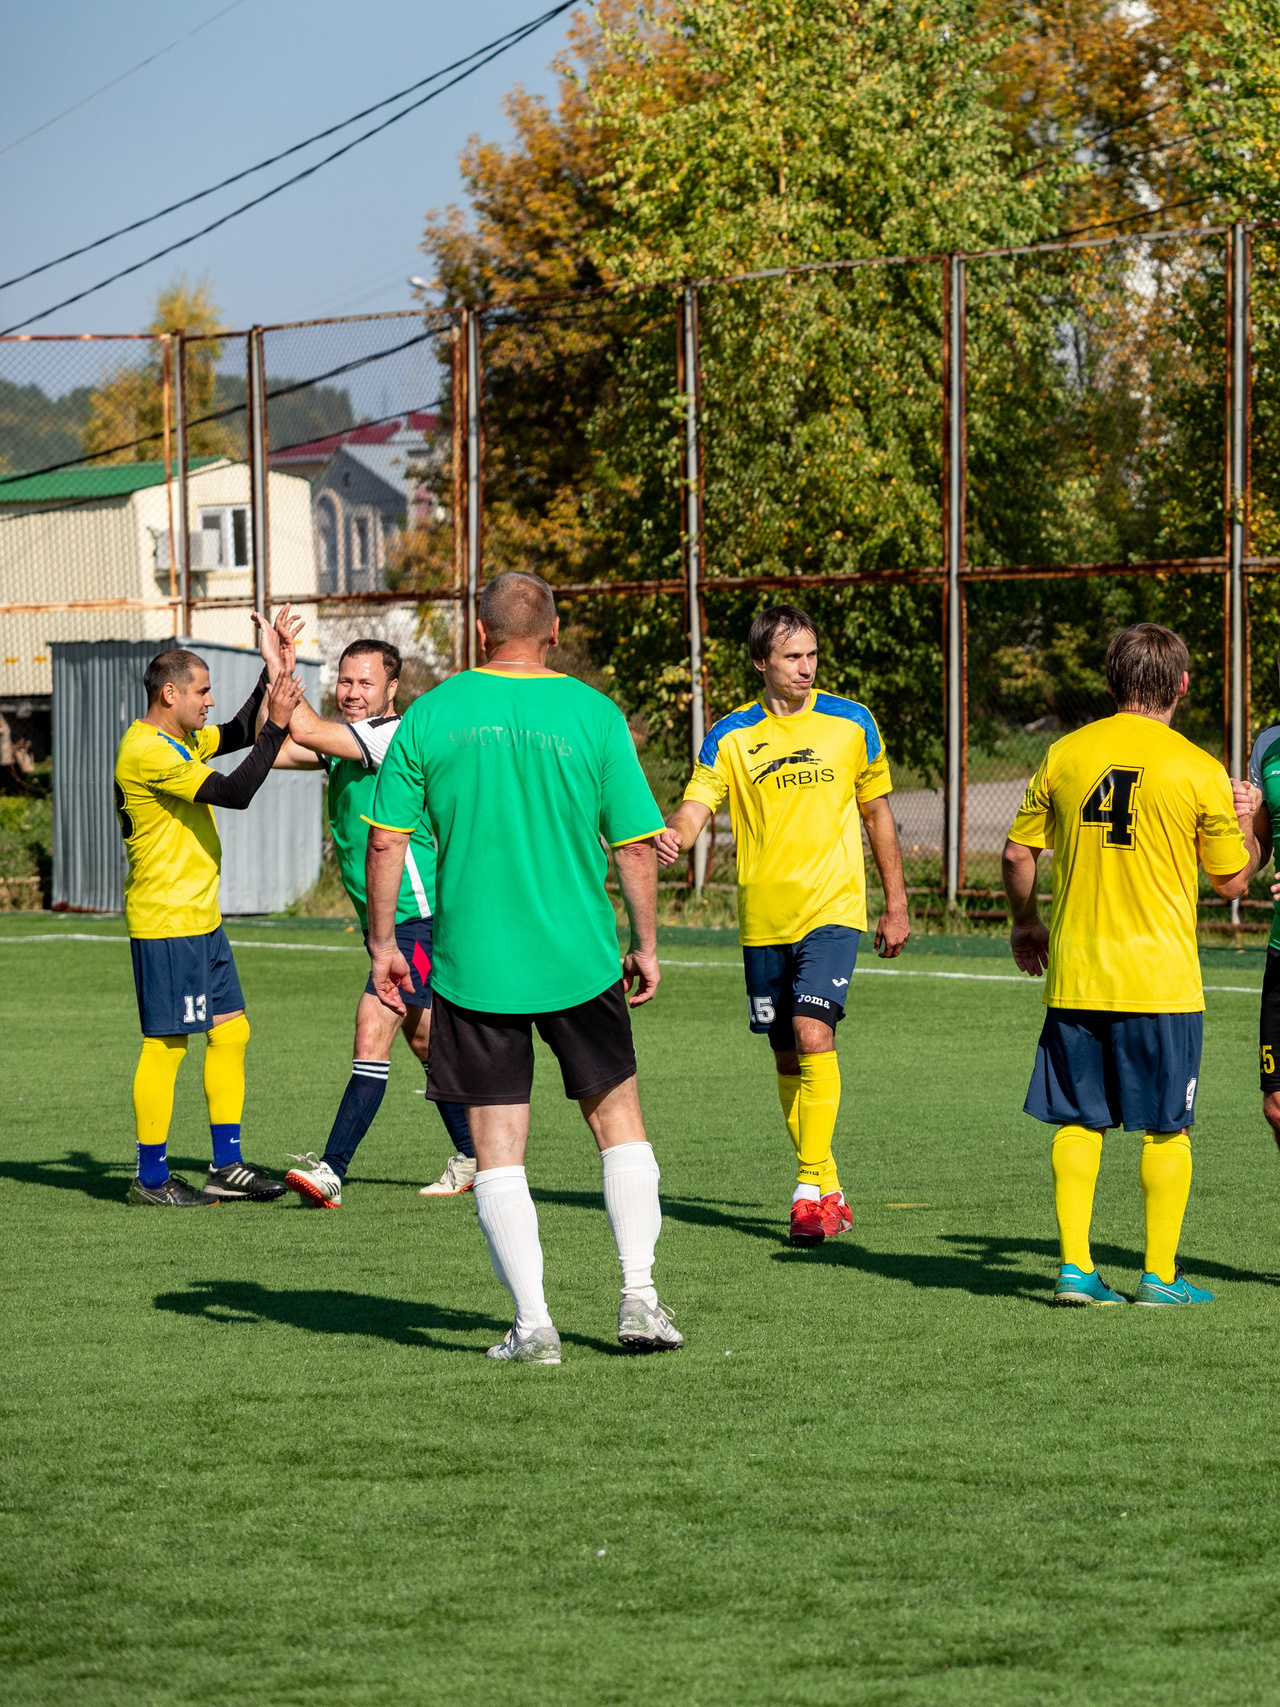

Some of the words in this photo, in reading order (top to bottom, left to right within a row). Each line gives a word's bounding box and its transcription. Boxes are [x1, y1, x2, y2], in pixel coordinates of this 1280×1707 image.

[775, 768, 835, 789] IRBIS
[1079, 764, 1144, 851] 4
[183, 993, 207, 1023] 13
